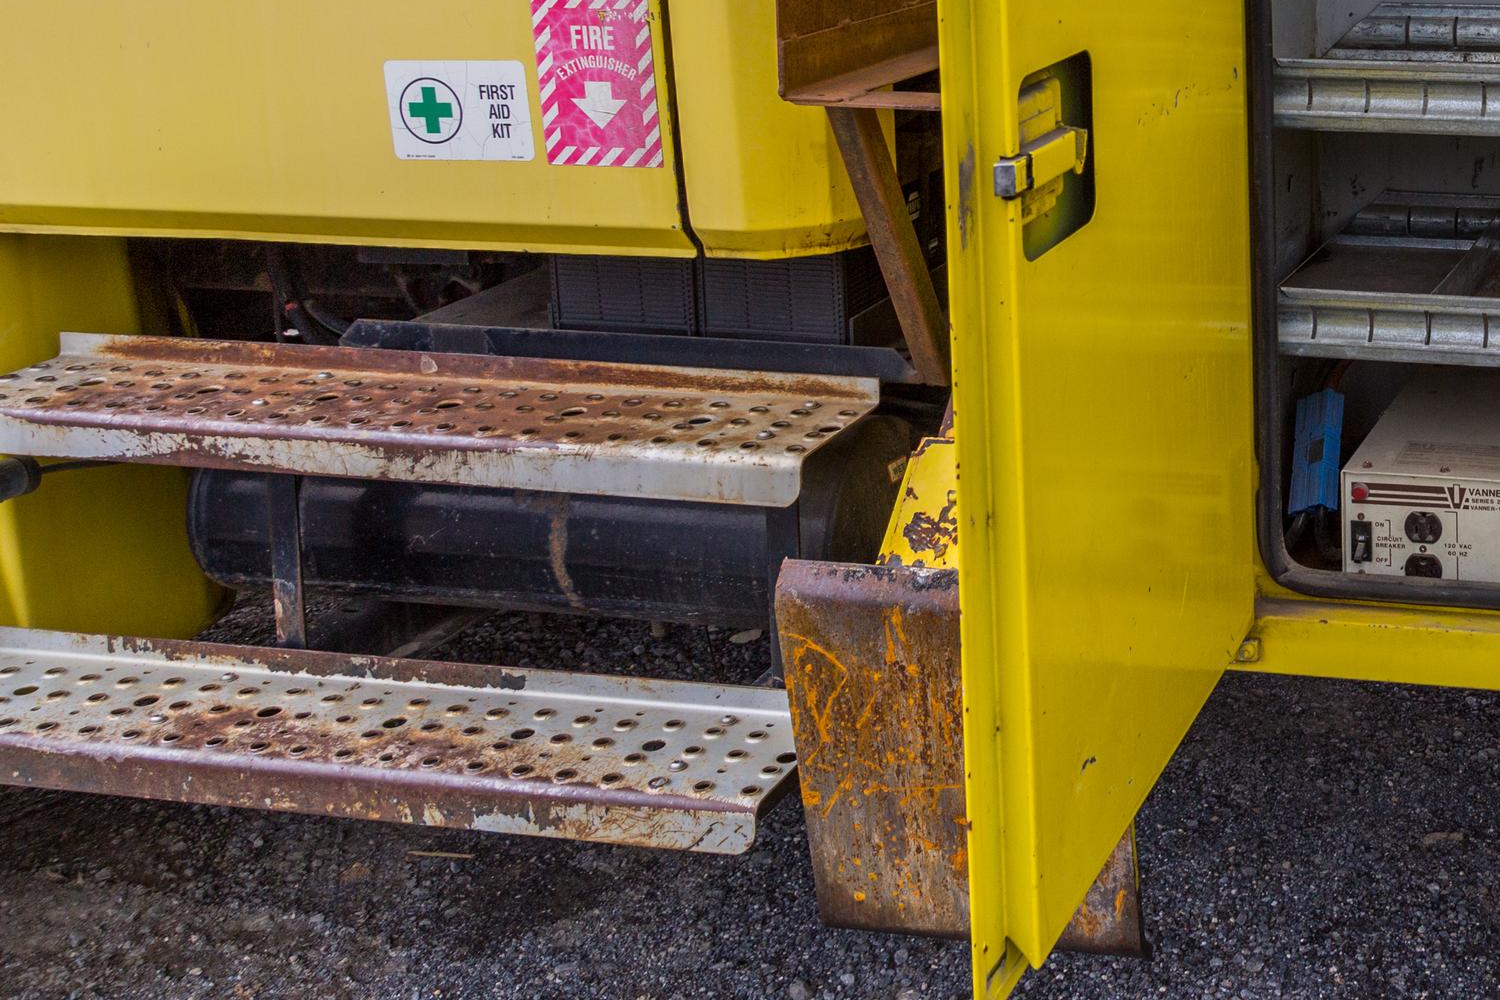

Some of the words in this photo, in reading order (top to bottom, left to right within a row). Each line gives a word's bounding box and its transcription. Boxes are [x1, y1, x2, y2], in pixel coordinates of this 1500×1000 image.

[570, 25, 615, 50] FIRE
[556, 55, 637, 81] EXTINGUISHER
[479, 84, 516, 100] FIRST
[489, 104, 511, 119] AID
[492, 123, 512, 139] KIT
